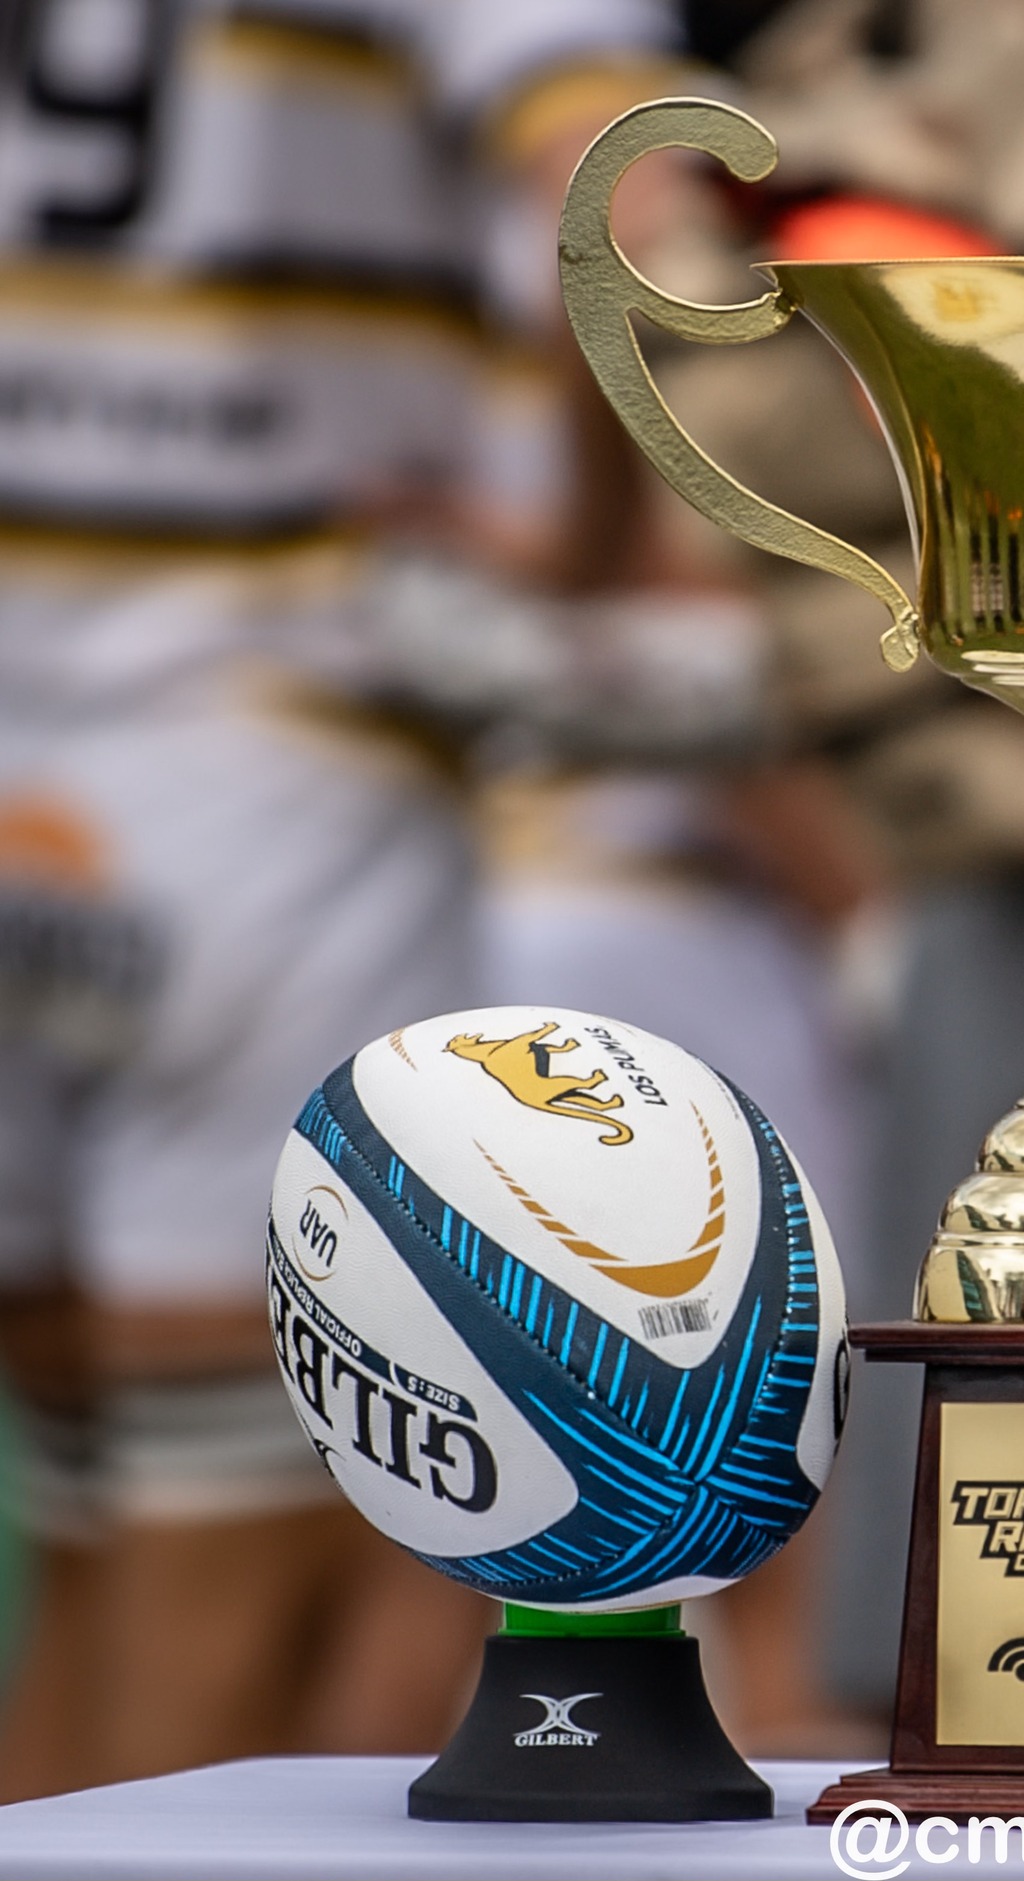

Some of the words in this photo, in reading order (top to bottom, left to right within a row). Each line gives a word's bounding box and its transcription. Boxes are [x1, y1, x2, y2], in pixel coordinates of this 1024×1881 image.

[583, 1027, 645, 1072] PUMAS
[627, 1074, 668, 1106] LOS
[300, 1199, 338, 1268] UAR
[314, 1303, 363, 1358] OFFICIAL
[266, 1238, 498, 1514] GILBE
[514, 1733, 598, 1748] GILBERT
